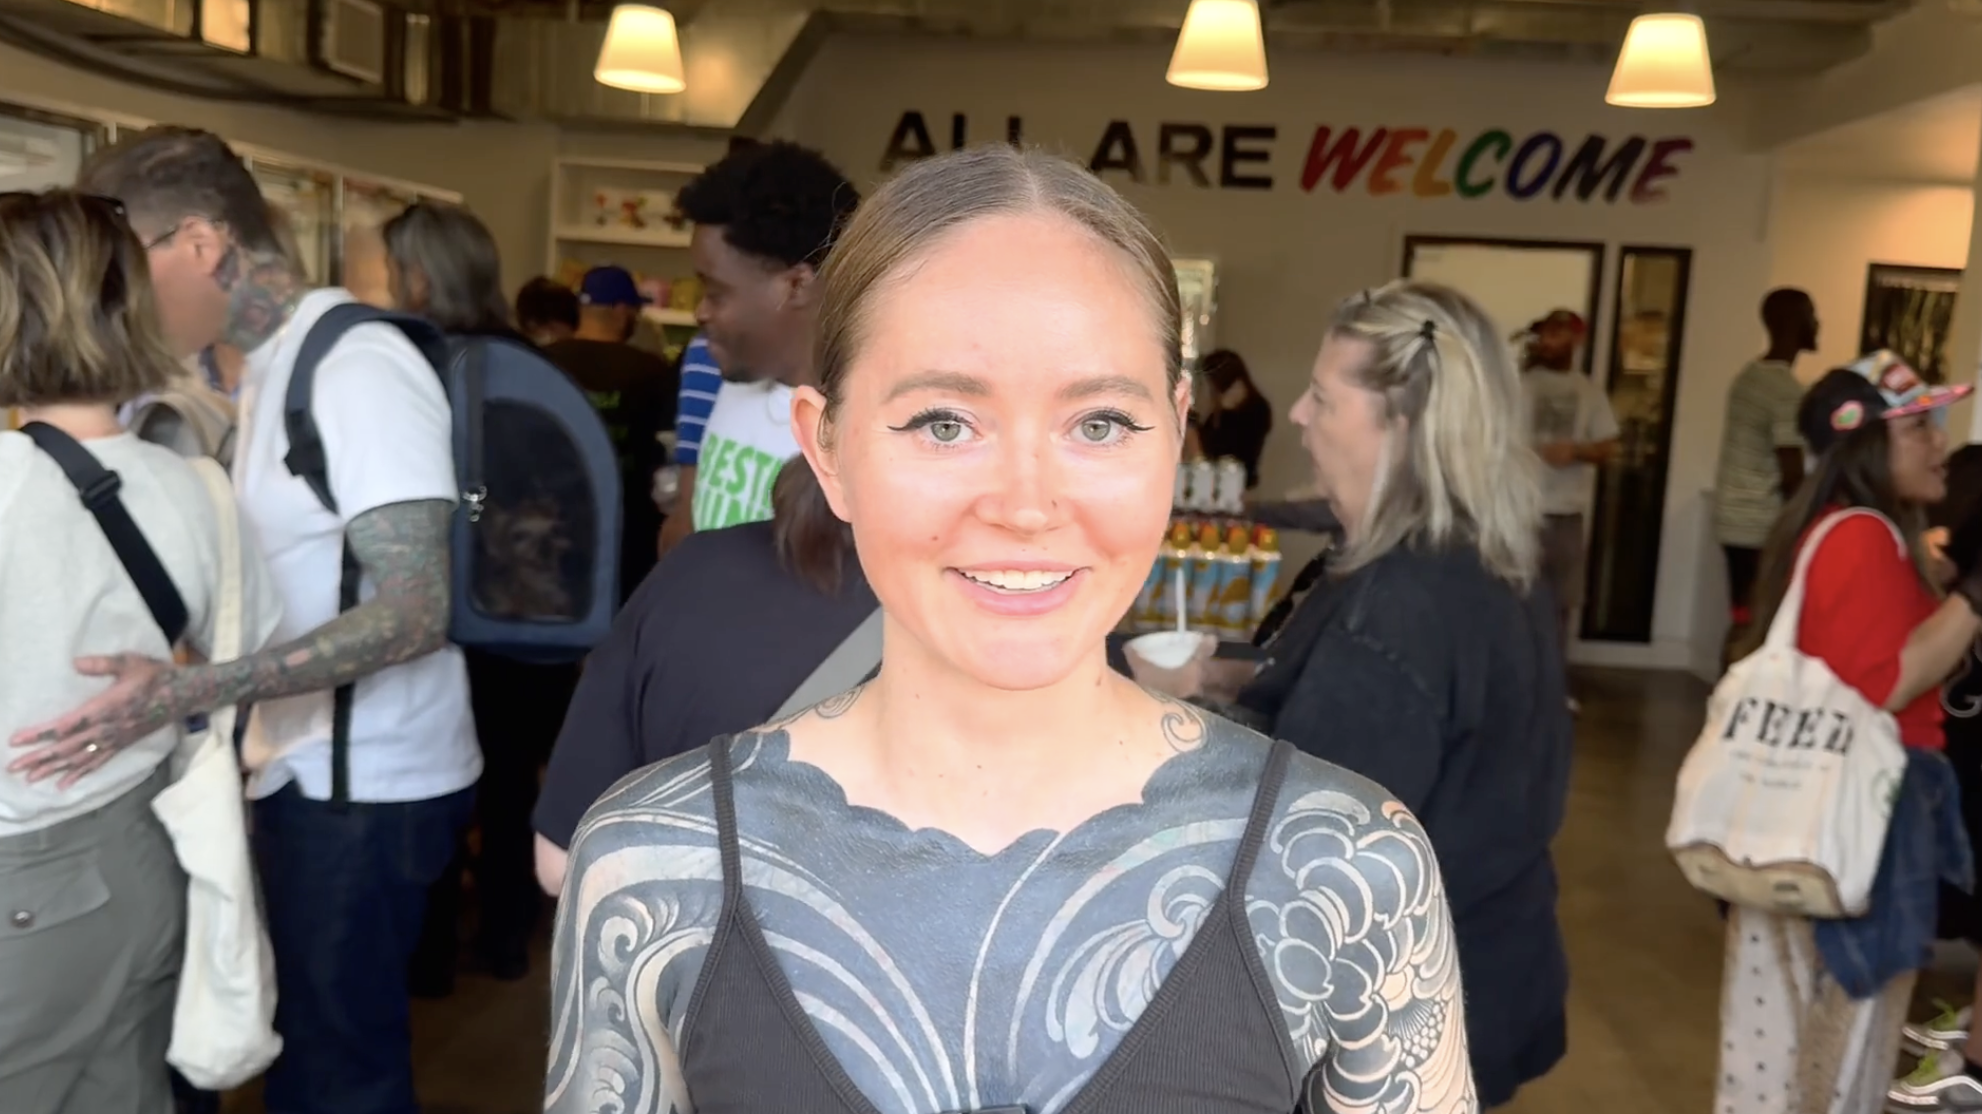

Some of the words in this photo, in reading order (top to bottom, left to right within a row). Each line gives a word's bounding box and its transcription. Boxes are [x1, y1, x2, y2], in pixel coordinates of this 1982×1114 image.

[1088, 120, 1277, 190] ARE
[1300, 125, 1694, 204] WELCOME
[1722, 698, 1854, 757] FEED
